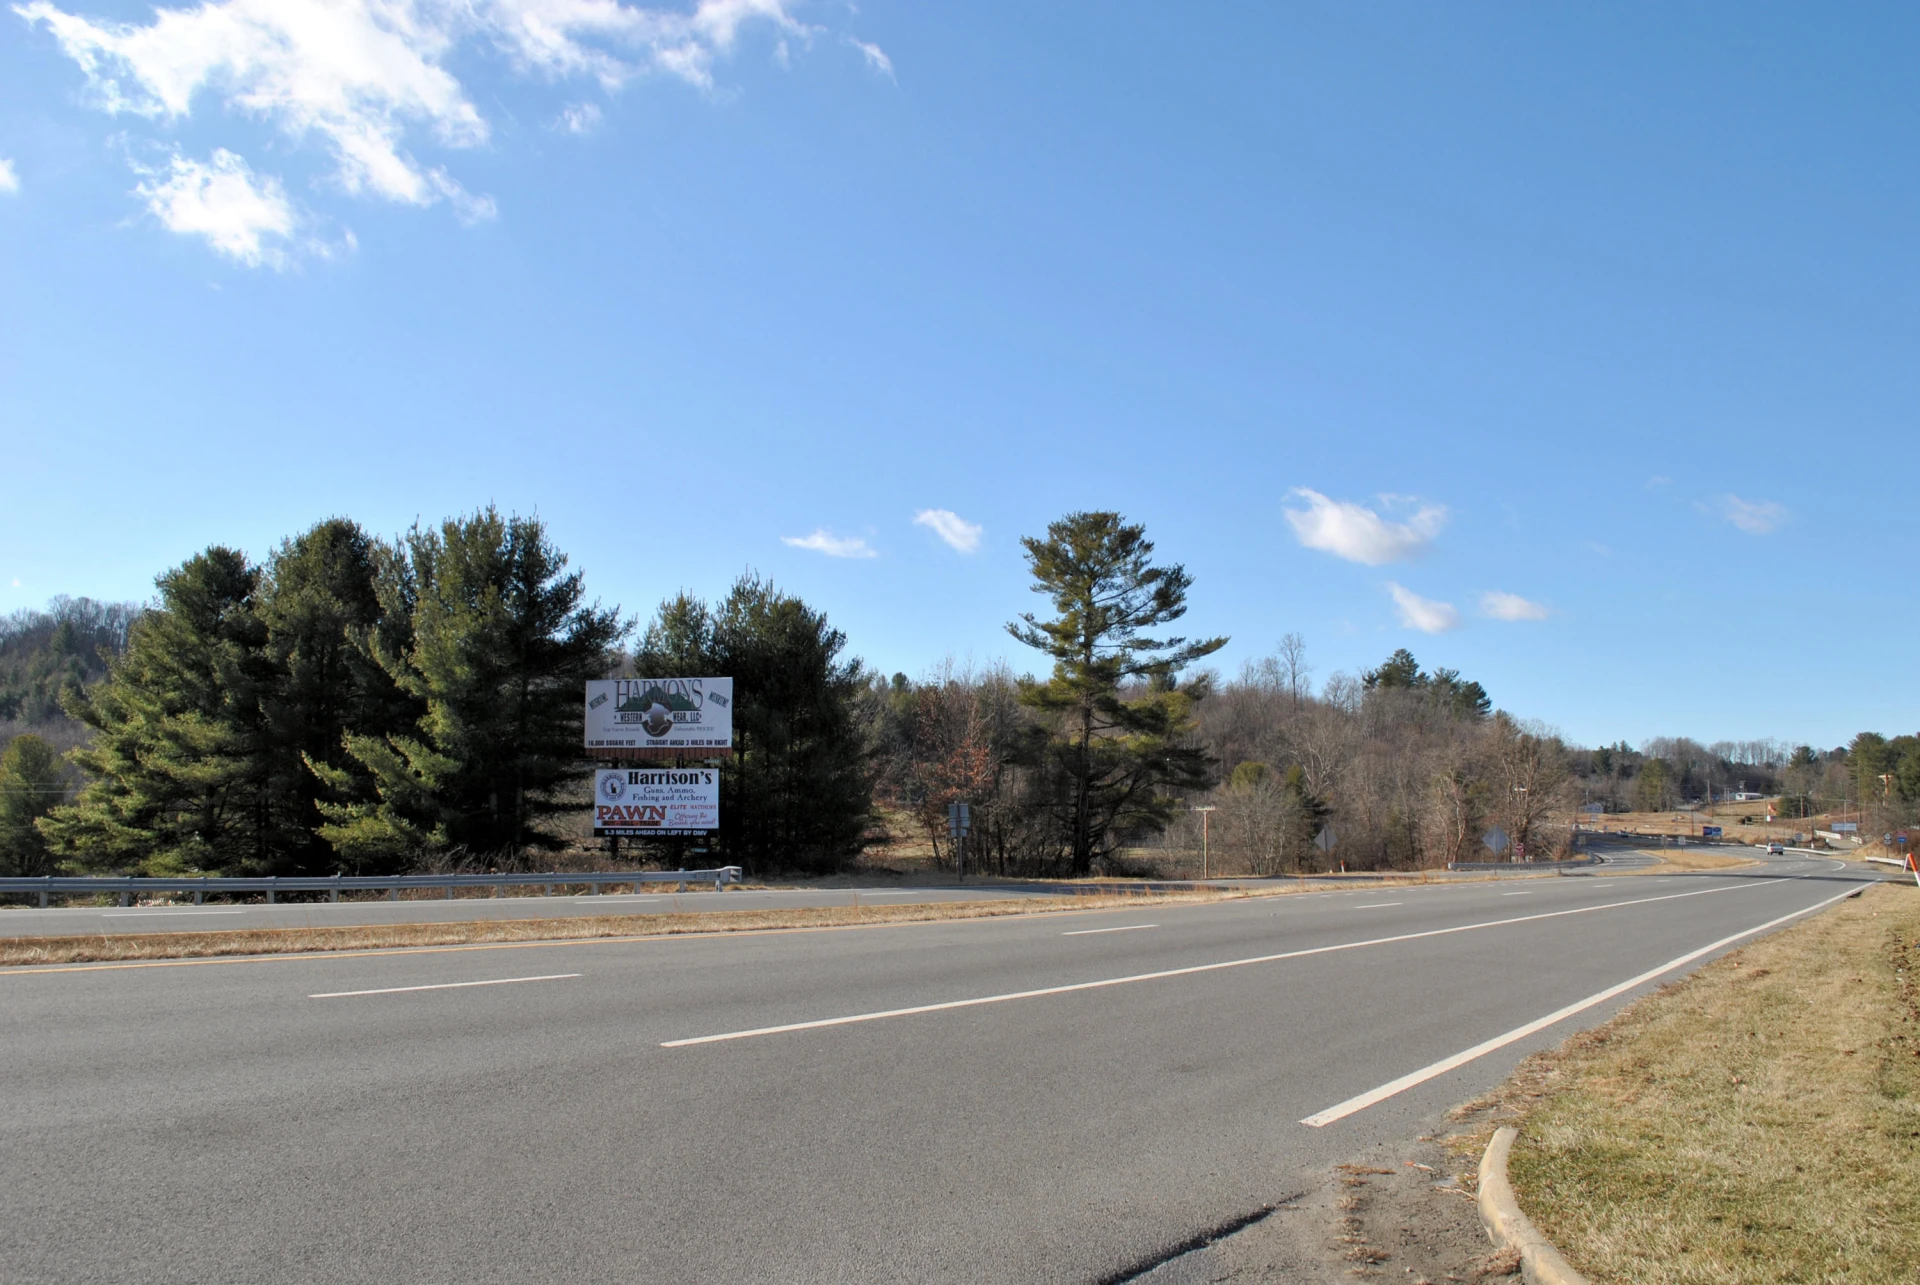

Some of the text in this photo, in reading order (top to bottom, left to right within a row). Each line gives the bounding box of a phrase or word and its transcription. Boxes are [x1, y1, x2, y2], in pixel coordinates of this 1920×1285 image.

[614, 679, 704, 710] HARMONS
[620, 712, 700, 722] WESTERN WEAR, LLC
[628, 771, 712, 784] Harrison's
[668, 786, 696, 794] Ammo,
[632, 793, 660, 802] Fishing
[679, 794, 708, 802] Archery
[596, 805, 667, 820] PAWN
